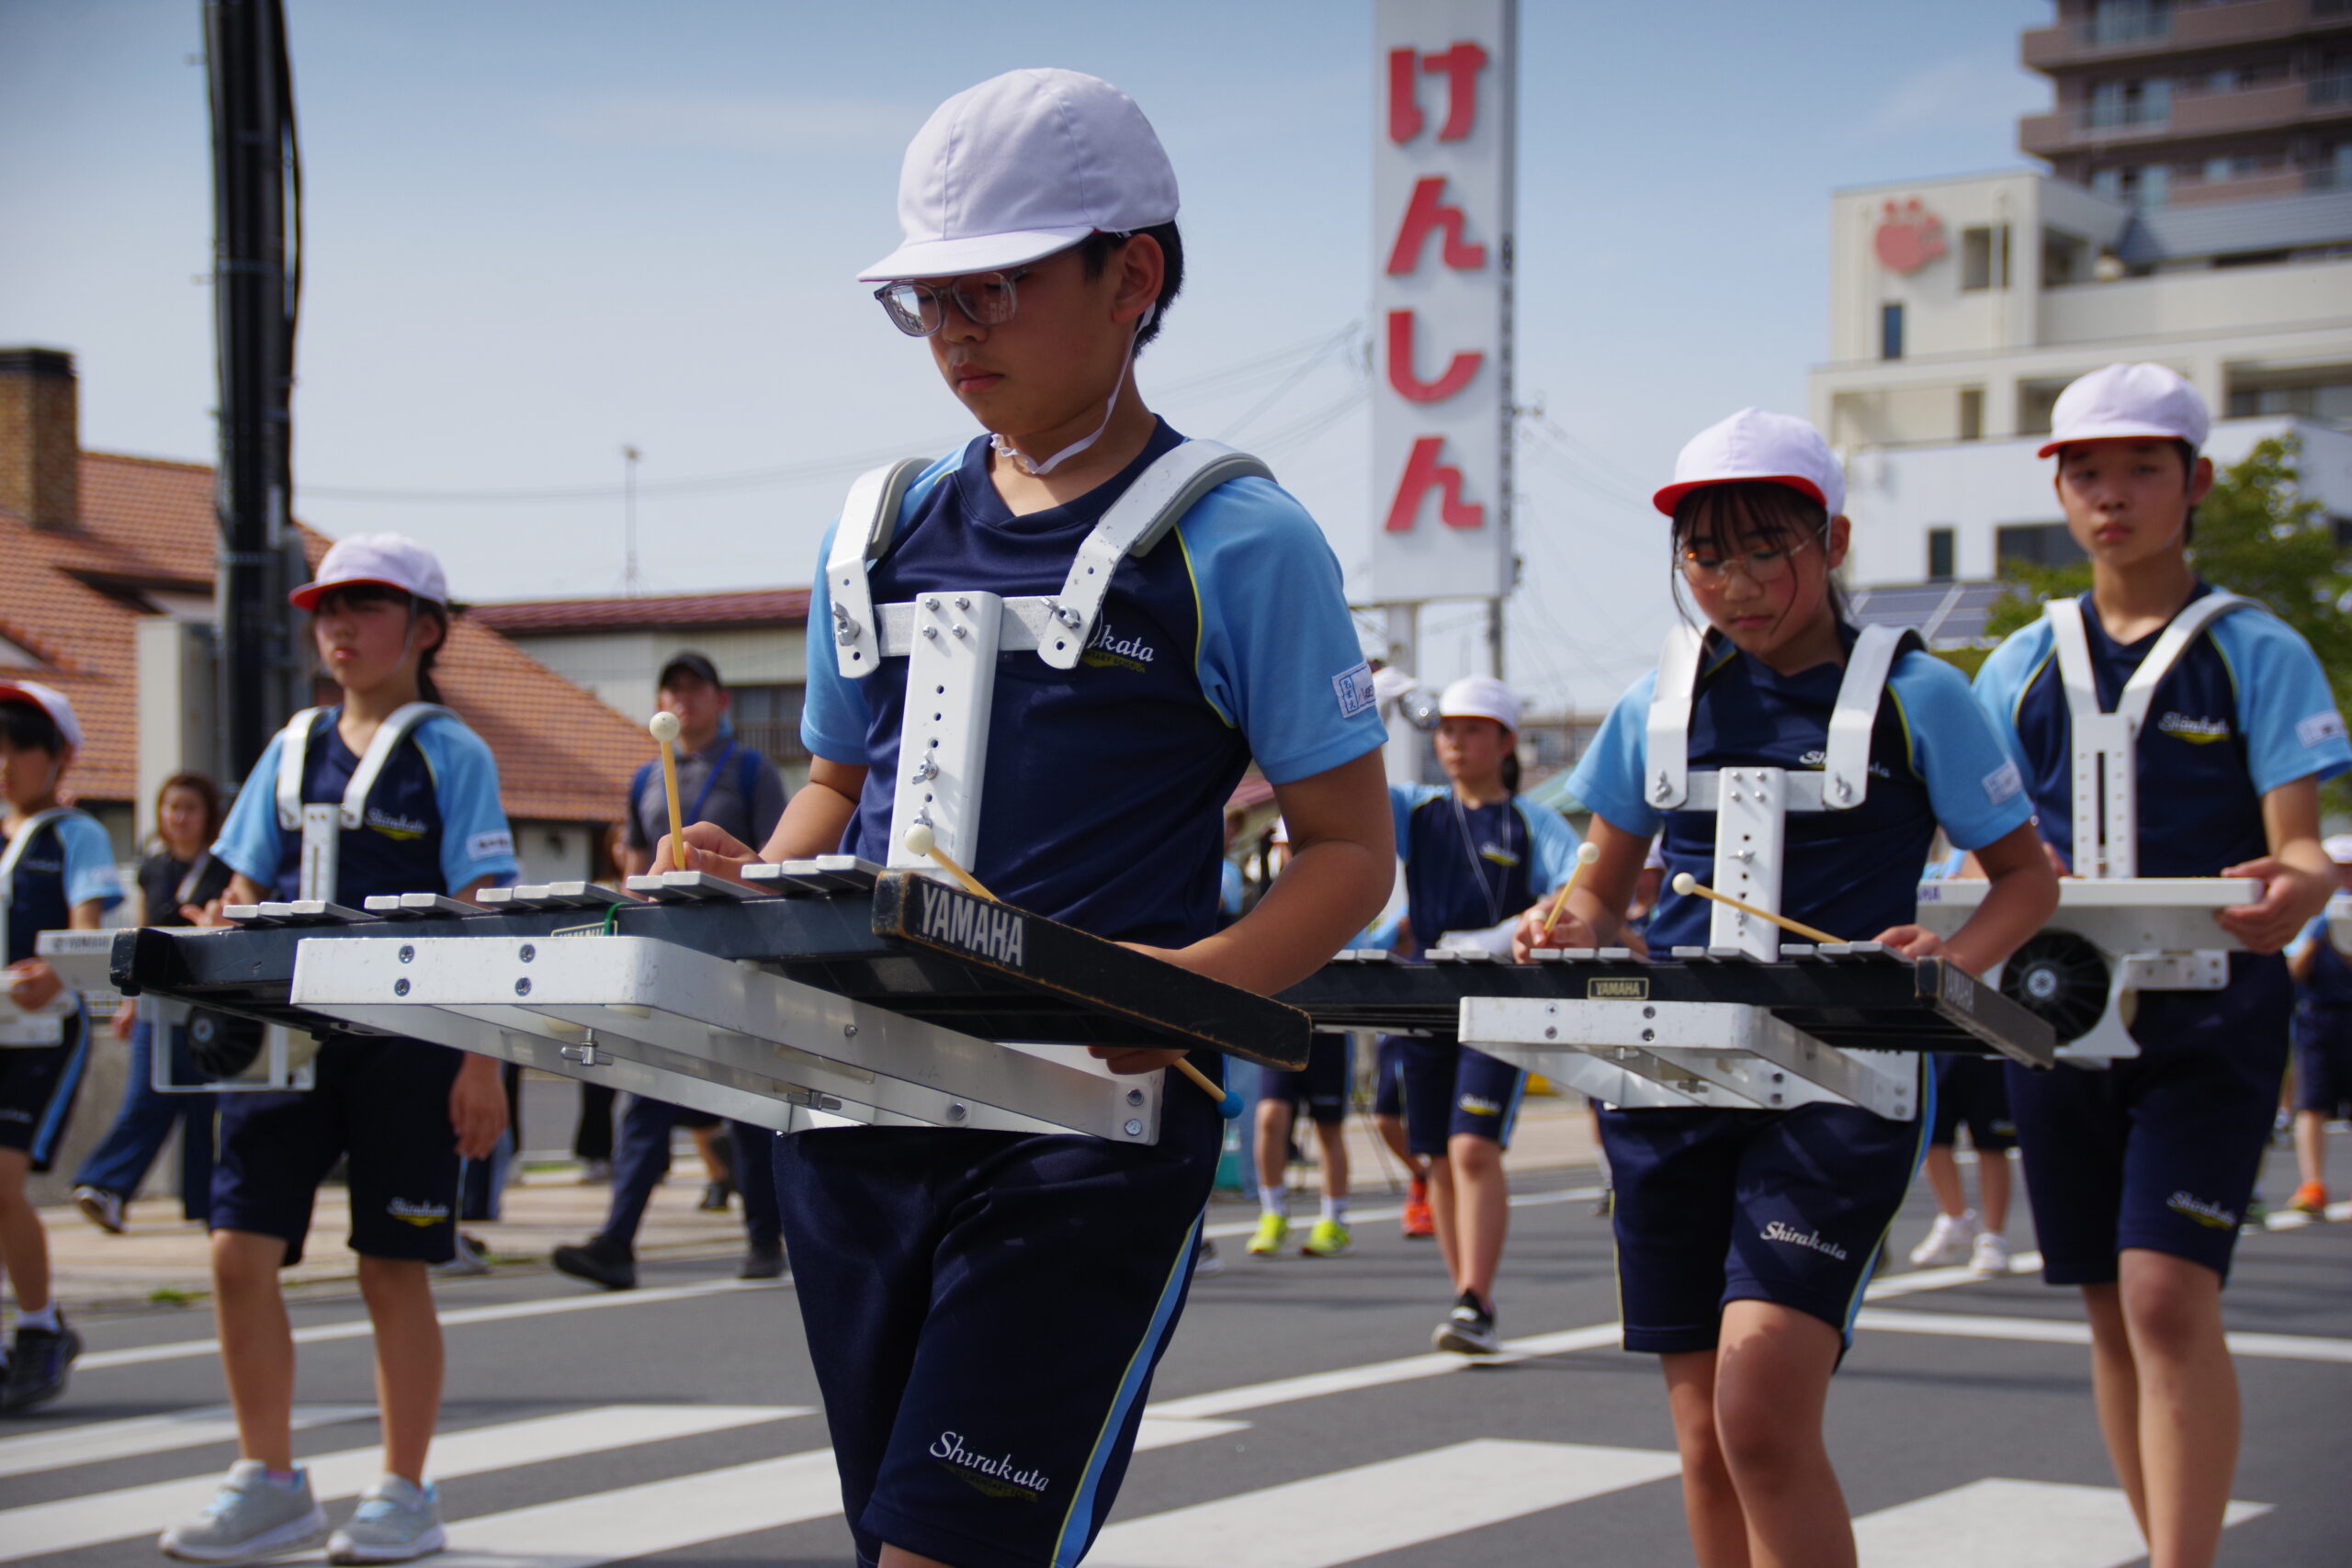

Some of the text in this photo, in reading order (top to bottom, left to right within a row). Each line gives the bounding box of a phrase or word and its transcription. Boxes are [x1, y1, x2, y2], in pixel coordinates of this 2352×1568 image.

[1385, 42, 1487, 532] けんしん
[922, 883, 1023, 967] YAMAHA
[1596, 982, 1640, 996] YAMAHA
[1759, 1221, 1848, 1261] Shirakata
[930, 1431, 1049, 1492] Shirakata
